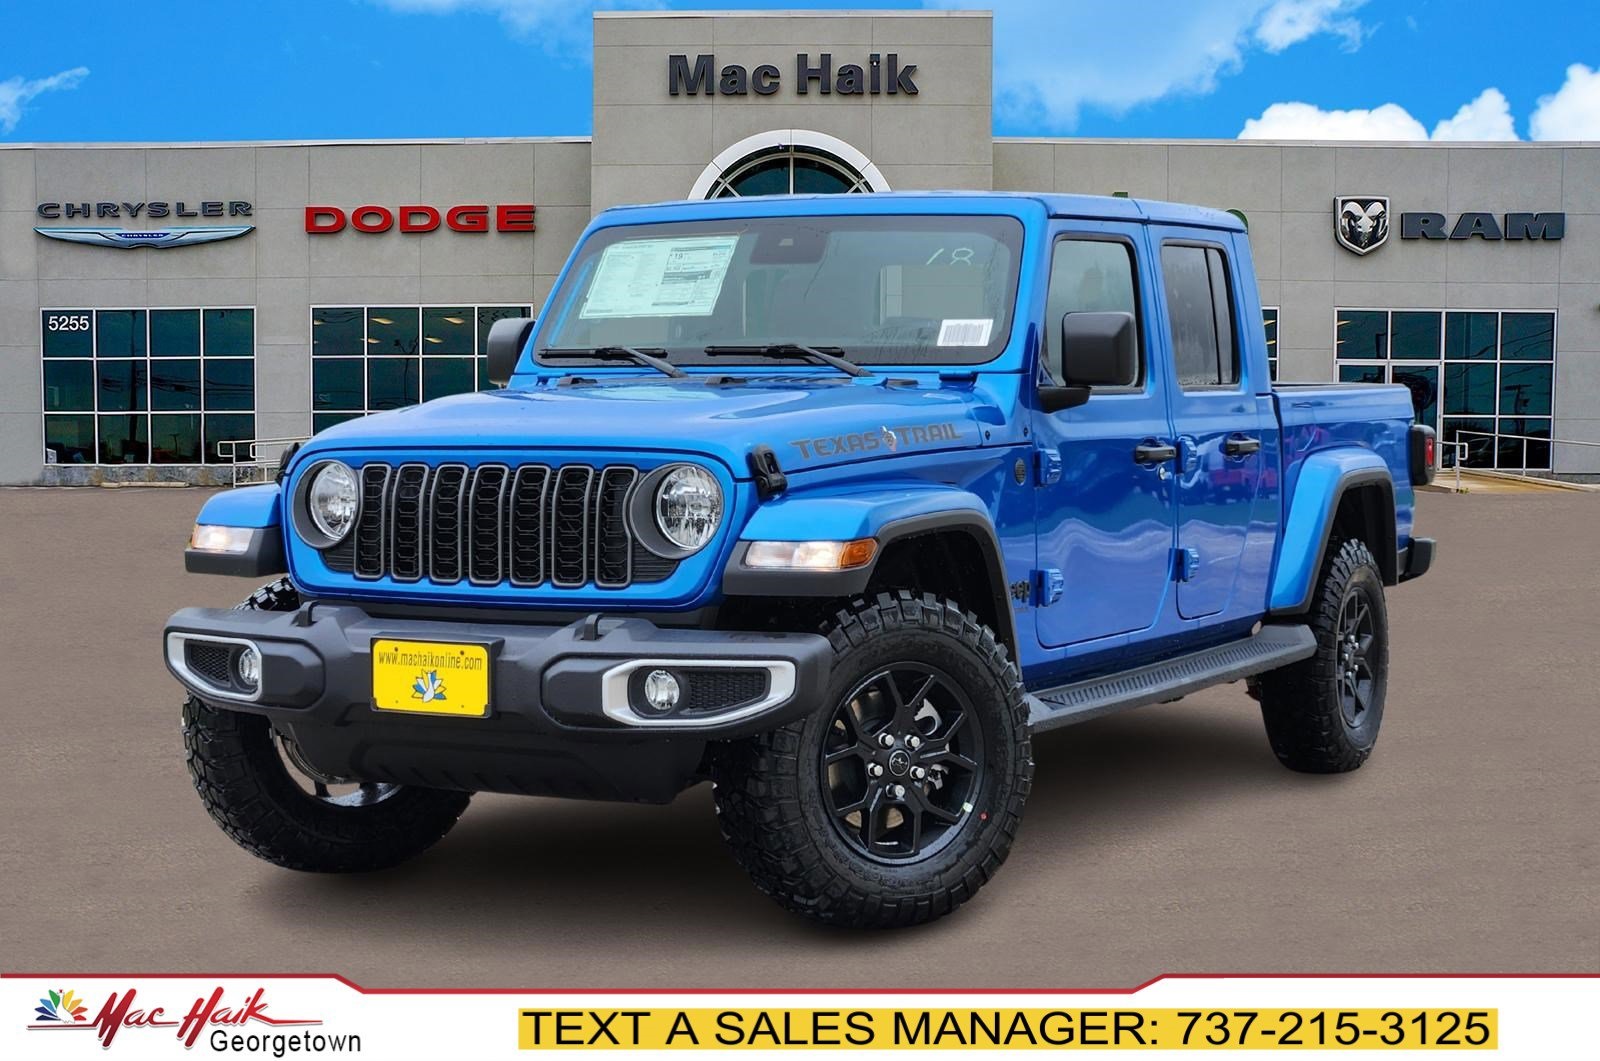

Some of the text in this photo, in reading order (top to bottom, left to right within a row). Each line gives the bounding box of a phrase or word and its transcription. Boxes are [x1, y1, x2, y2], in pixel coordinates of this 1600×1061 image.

[669, 53, 919, 95] Mac Haik
[37, 201, 253, 218] CHRYSLER
[305, 205, 536, 233] DODGE
[1401, 212, 1566, 240] RAM
[48, 315, 90, 331] 5255
[790, 423, 963, 460] TEXAS TRAIL
[378, 652, 482, 670] www.machaikonline.com
